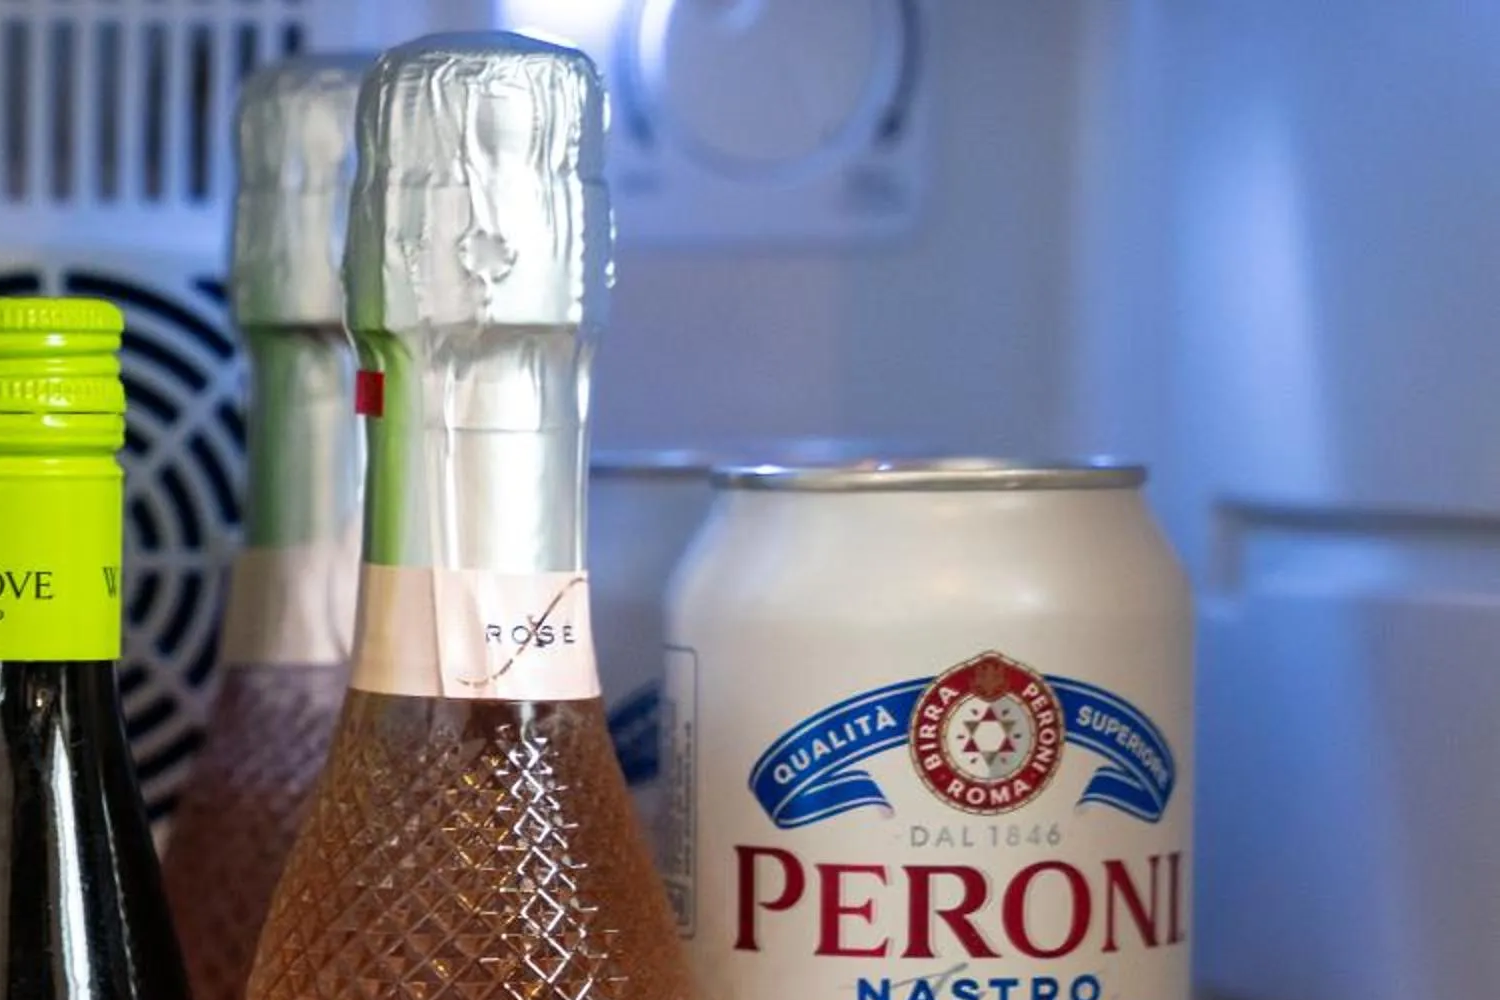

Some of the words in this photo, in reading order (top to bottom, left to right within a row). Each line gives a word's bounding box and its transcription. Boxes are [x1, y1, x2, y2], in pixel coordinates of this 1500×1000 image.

[772, 704, 898, 785] QUALITÀ
[919, 686, 960, 771] BIRRA
[1022, 682, 1057, 774] PERONI
[947, 778, 1032, 806] ROMA
[910, 826, 975, 848] DAL
[988, 823, 1062, 848] 1846
[733, 843, 1186, 960] PERONI
